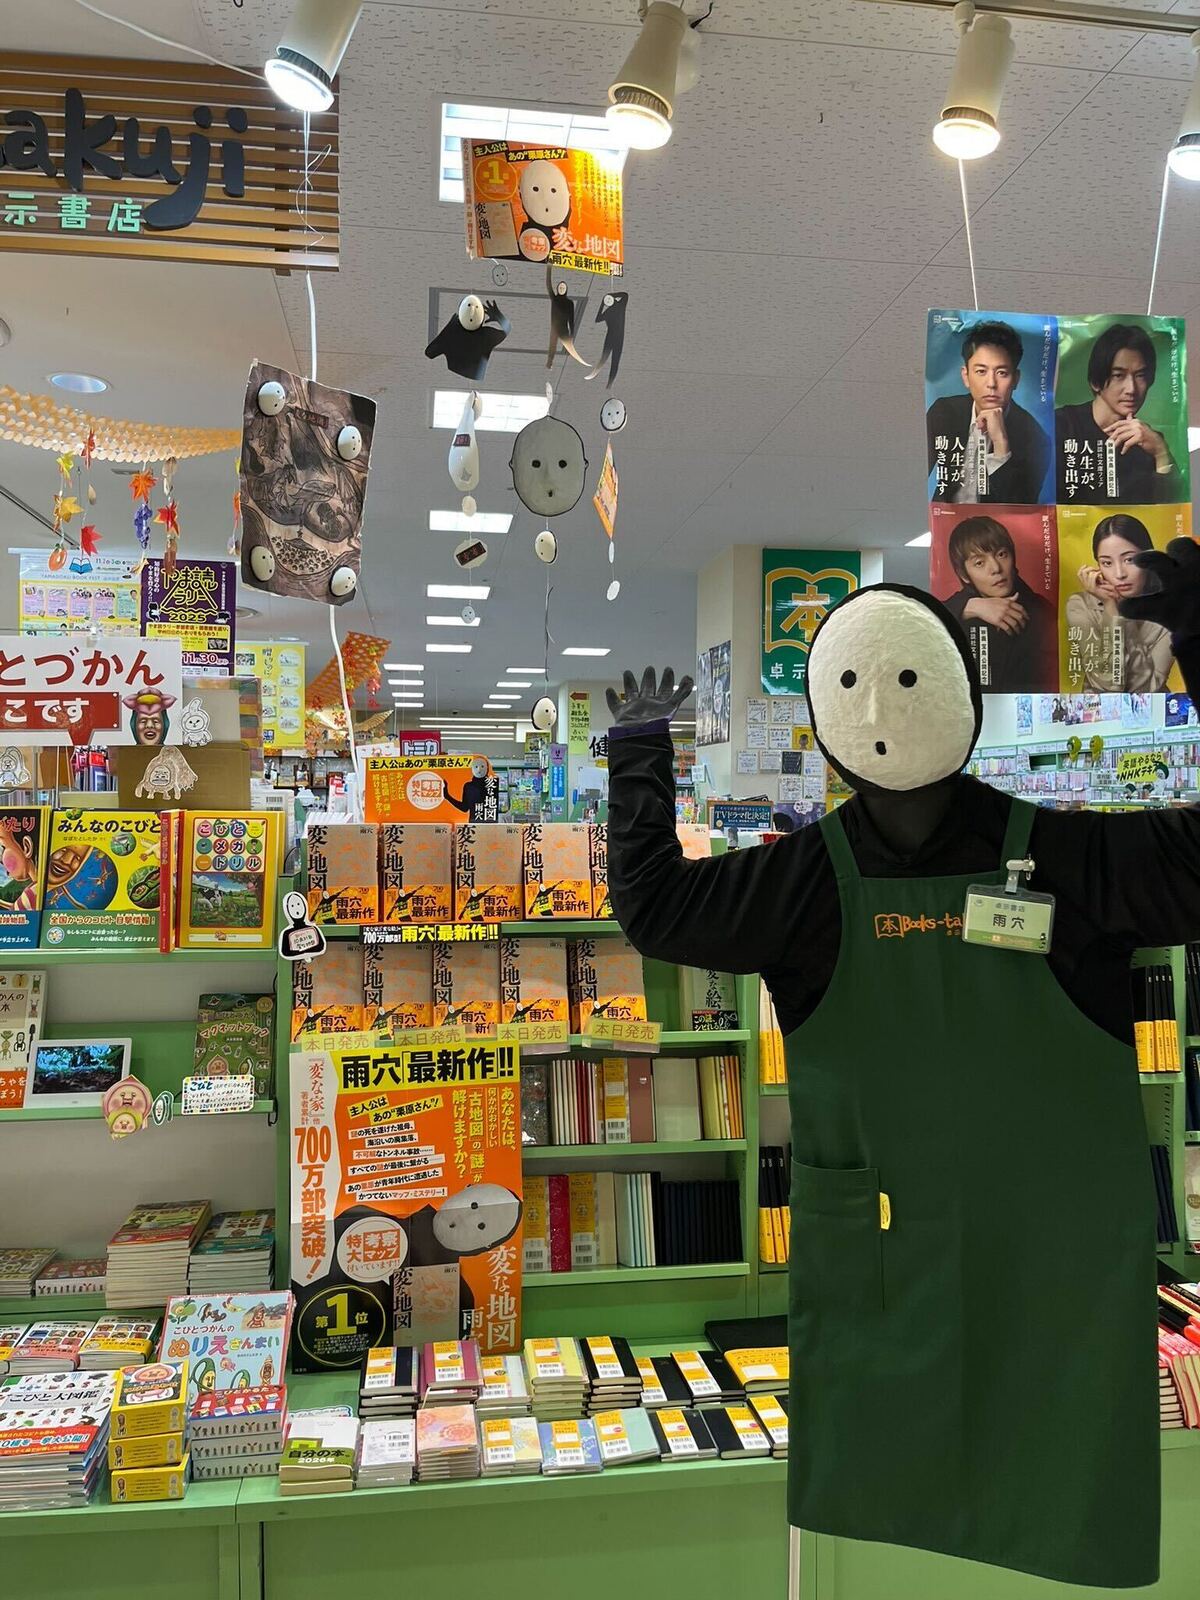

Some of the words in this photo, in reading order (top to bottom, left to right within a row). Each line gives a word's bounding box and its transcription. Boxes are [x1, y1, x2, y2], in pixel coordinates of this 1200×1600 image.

[0, 88, 248, 230] akuji
[5, 191, 142, 232] 示書店
[552, 253, 572, 266] 雨穴
[935, 435, 949, 496] 動き出す
[950, 437, 965, 487] 人生が、
[1063, 438, 1079, 498] 動き出す
[1080, 440, 1095, 490] 人生が、
[169, 612, 207, 623] 2025
[1068, 626, 1083, 687] 動き出す
[0, 647, 164, 687] とづかん
[404, 741, 438, 756] トミカ
[484, 776, 498, 821] 変な地図
[474, 803, 484, 821] 雨穴
[3, 816, 36, 832] たり
[57, 819, 161, 833] みんなのこびと
[199, 823, 245, 837] こびと
[215, 840, 244, 852] メガ
[525, 824, 543, 885] 変な地図
[216, 857, 260, 869] ドリル
[308, 825, 327, 890] 変な地図
[384, 825, 404, 890] 変な地図
[456, 825, 476, 890] 変な地図
[336, 896, 362, 907] 雨穴
[412, 896, 437, 906] 雨穴
[483, 895, 508, 906] 雨穴
[552, 890, 577, 901] 雨穴
[336, 907, 375, 919] 最新作
[411, 907, 449, 917] 最新作
[483, 906, 520, 917] 最新作
[552, 900, 589, 911] 最新作
[902, 912, 963, 933] Books-ta
[993, 914, 1025, 931] 雨穴
[402, 925, 499, 943] 雨穴「最新作」!!
[363, 944, 384, 1008] 変な地図
[432, 943, 453, 1008] 変な地図
[501, 938, 521, 1004] 変な地図
[578, 939, 598, 1004] 変な地図
[293, 961, 313, 1009] な地図
[391, 1013, 417, 1024] 雨穴
[461, 1012, 486, 1023] 雨穴
[529, 1009, 554, 1020] 雨穴
[607, 1007, 632, 1017] 雨穴
[320, 1016, 347, 1027] 雨穴
[200, 1022, 269, 1040] マグネットブック
[400, 1028, 461, 1046] 本日発売
[501, 1024, 562, 1040] 本日発売
[595, 1023, 655, 1041] 本日発売
[305, 1034, 370, 1051] 本日発売
[341, 1047, 514, 1089] 雨穴「最新作」!!
[350, 1096, 388, 1117] 主人公は
[487, 1087, 498, 1148] 何かがおかしい
[501, 1086, 516, 1152] あなたは、
[452, 1089, 468, 1178] 解けますか？
[365, 1231, 399, 1248] 考察
[346, 1234, 362, 1264] 特大
[364, 1246, 398, 1260] マップ
[393, 1268, 413, 1331] 変な地図
[486, 1245, 518, 1351] 変な地図
[315, 1293, 369, 1337] 第1位
[168, 1334, 280, 1359] ぬりえさんまい
